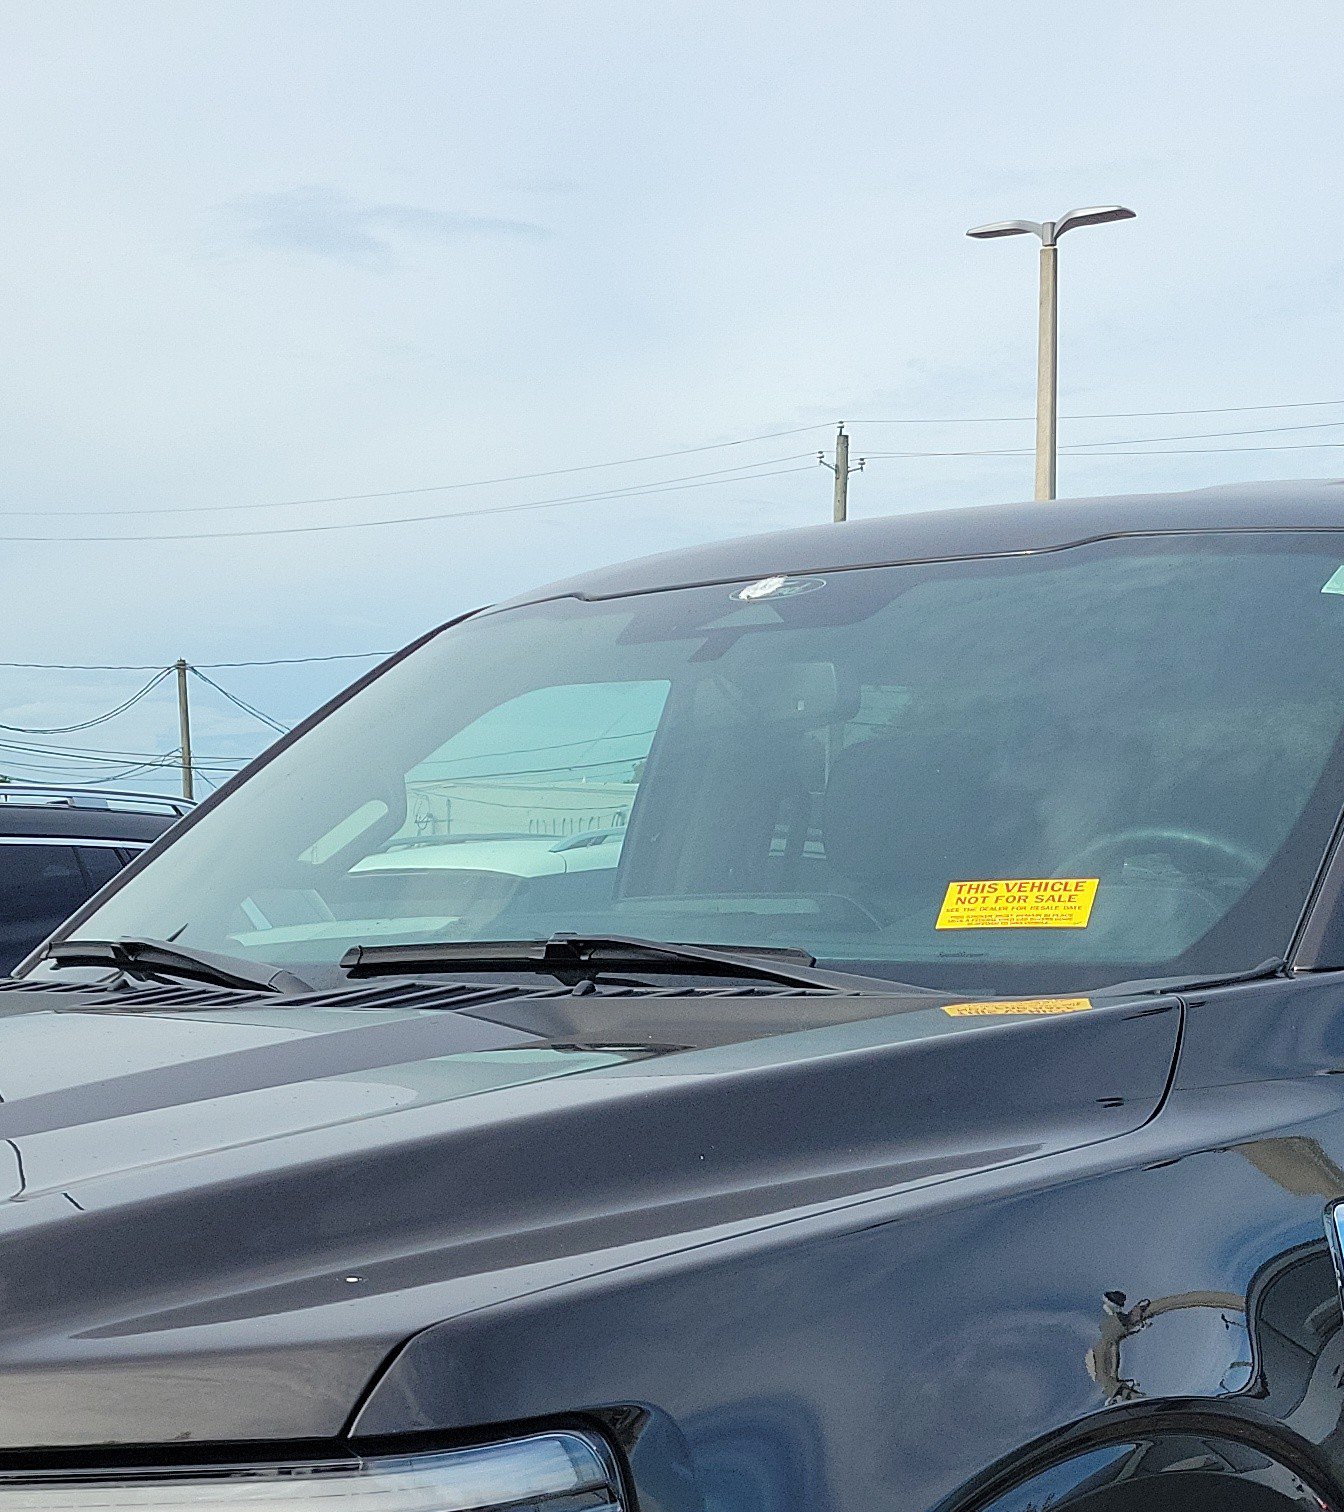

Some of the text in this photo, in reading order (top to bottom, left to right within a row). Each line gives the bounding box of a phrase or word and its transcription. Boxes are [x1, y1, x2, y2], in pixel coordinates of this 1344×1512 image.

[956, 880, 1087, 895] THIS VEHICLE
[955, 893, 1079, 905] NOT FOR SALE
